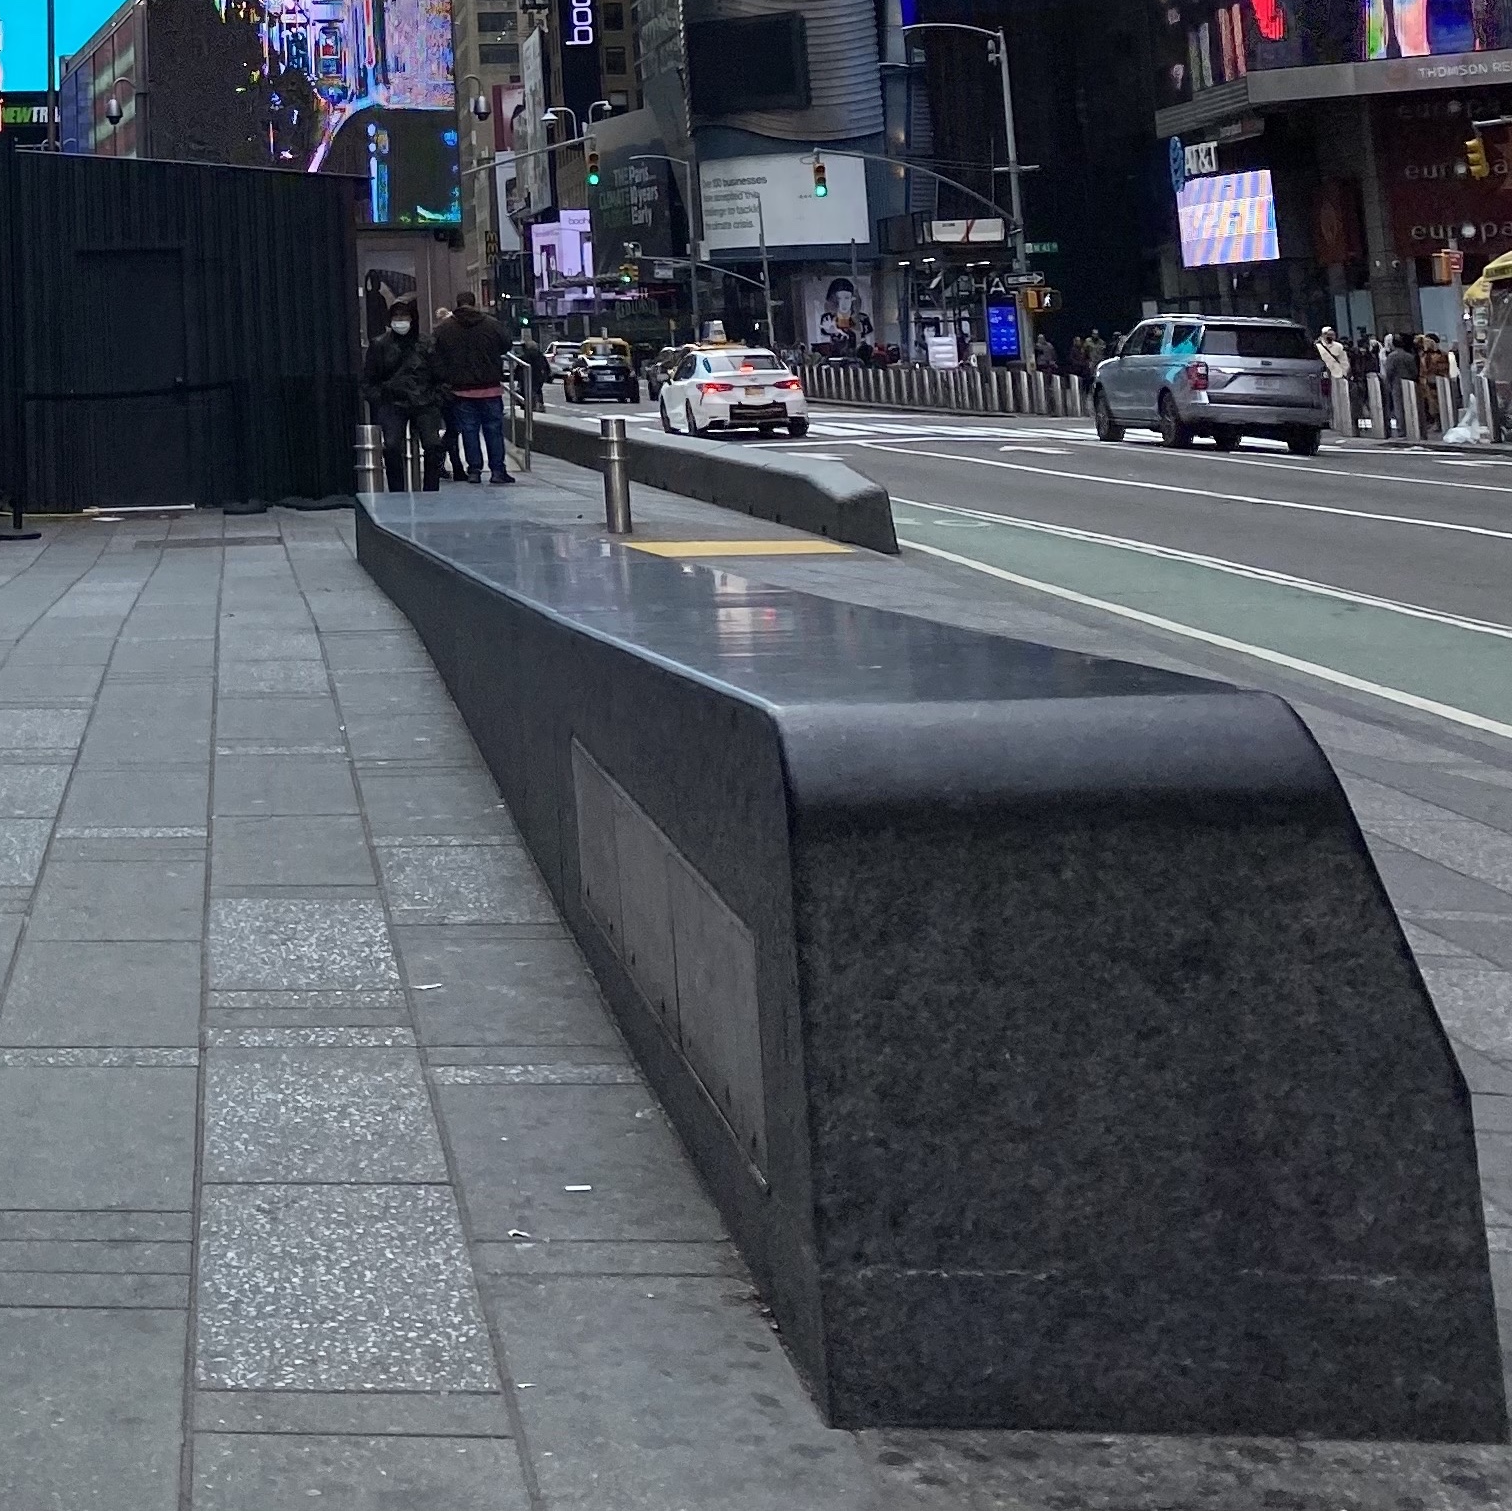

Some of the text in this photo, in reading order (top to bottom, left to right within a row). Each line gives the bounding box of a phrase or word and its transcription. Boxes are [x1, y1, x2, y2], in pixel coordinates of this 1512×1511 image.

[1417, 60, 1489, 79] THOMSON
[1184, 140, 1219, 177] AT&T
[1404, 158, 1508, 180] euroa
